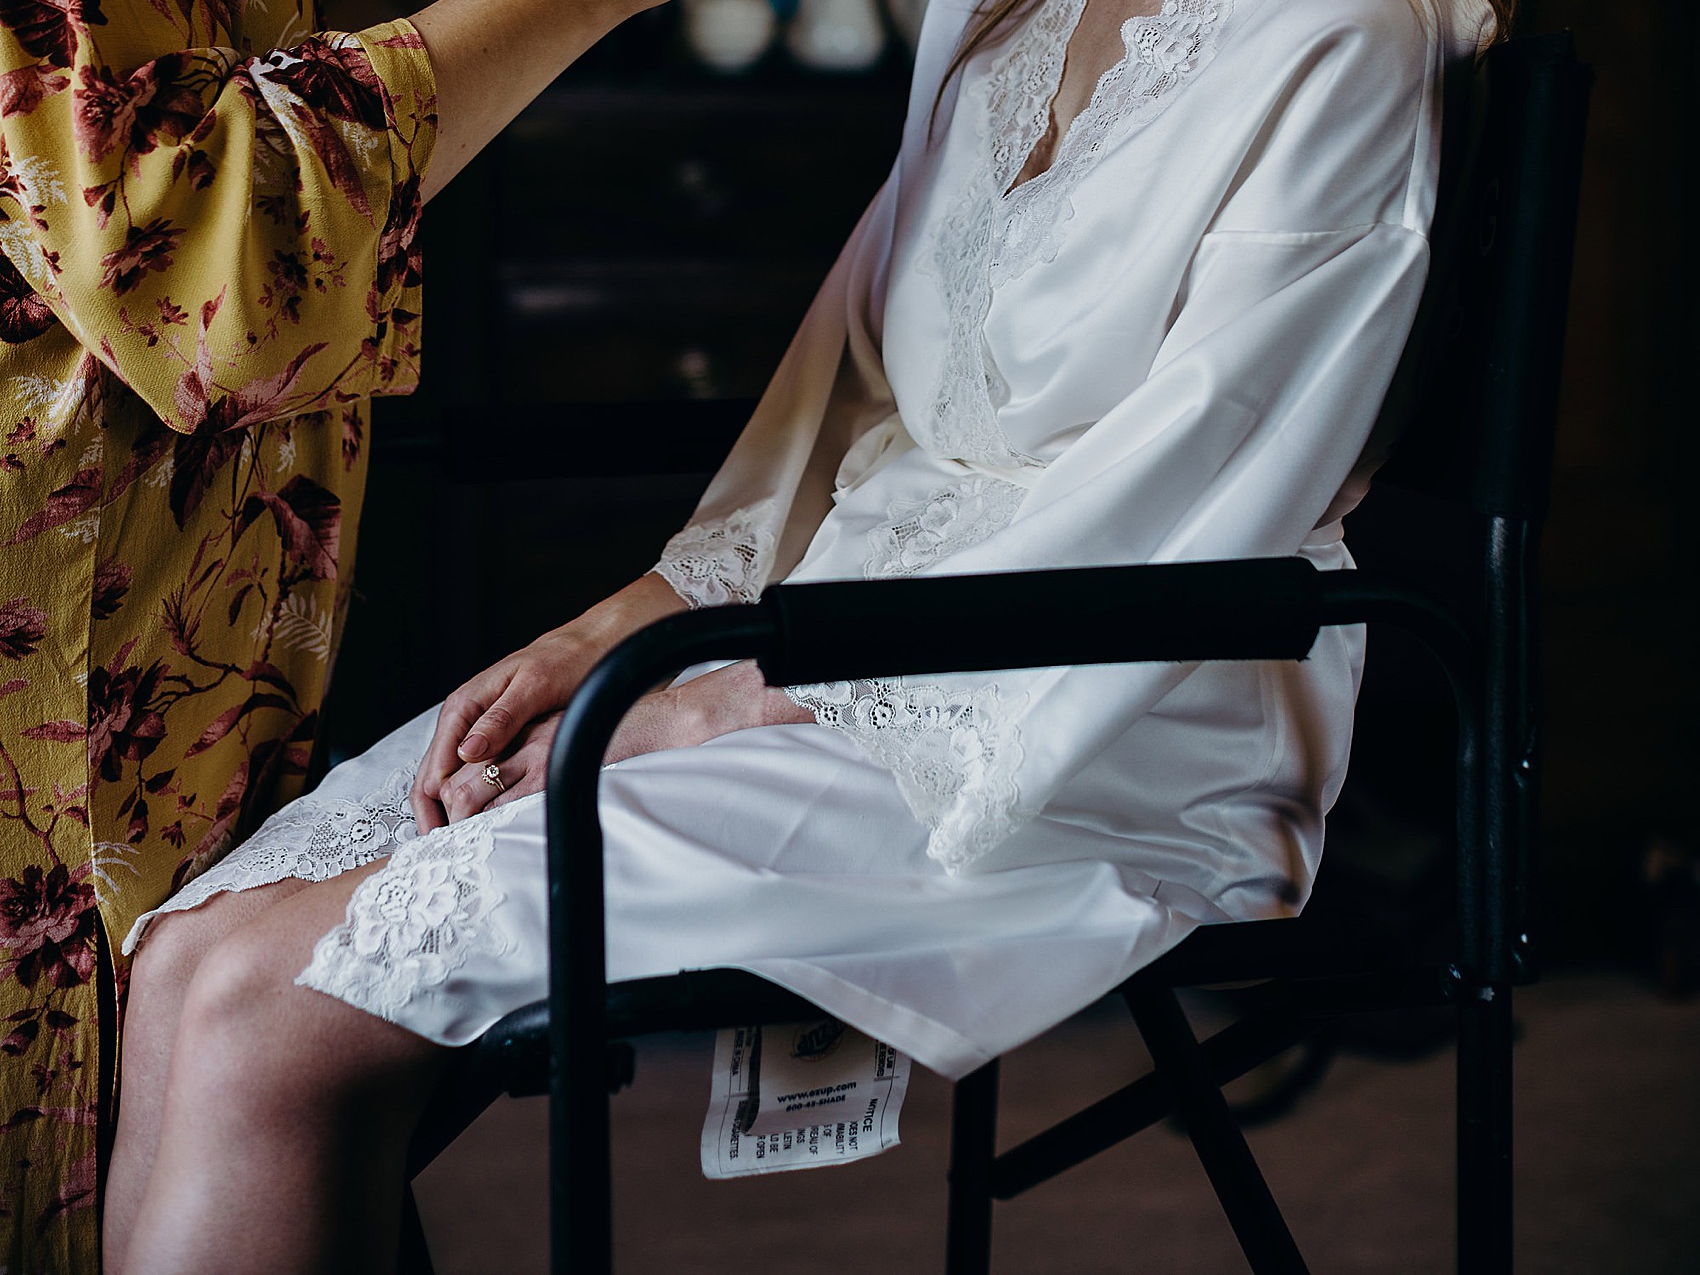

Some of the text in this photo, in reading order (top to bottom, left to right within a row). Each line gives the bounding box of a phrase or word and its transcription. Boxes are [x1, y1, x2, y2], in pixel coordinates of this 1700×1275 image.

[862, 1098, 878, 1132] NOTICE
[756, 1141, 766, 1158] OPEN
[770, 1144, 779, 1153] BE
[849, 1137, 858, 1150] NOT
[809, 1146, 818, 1155] OF
